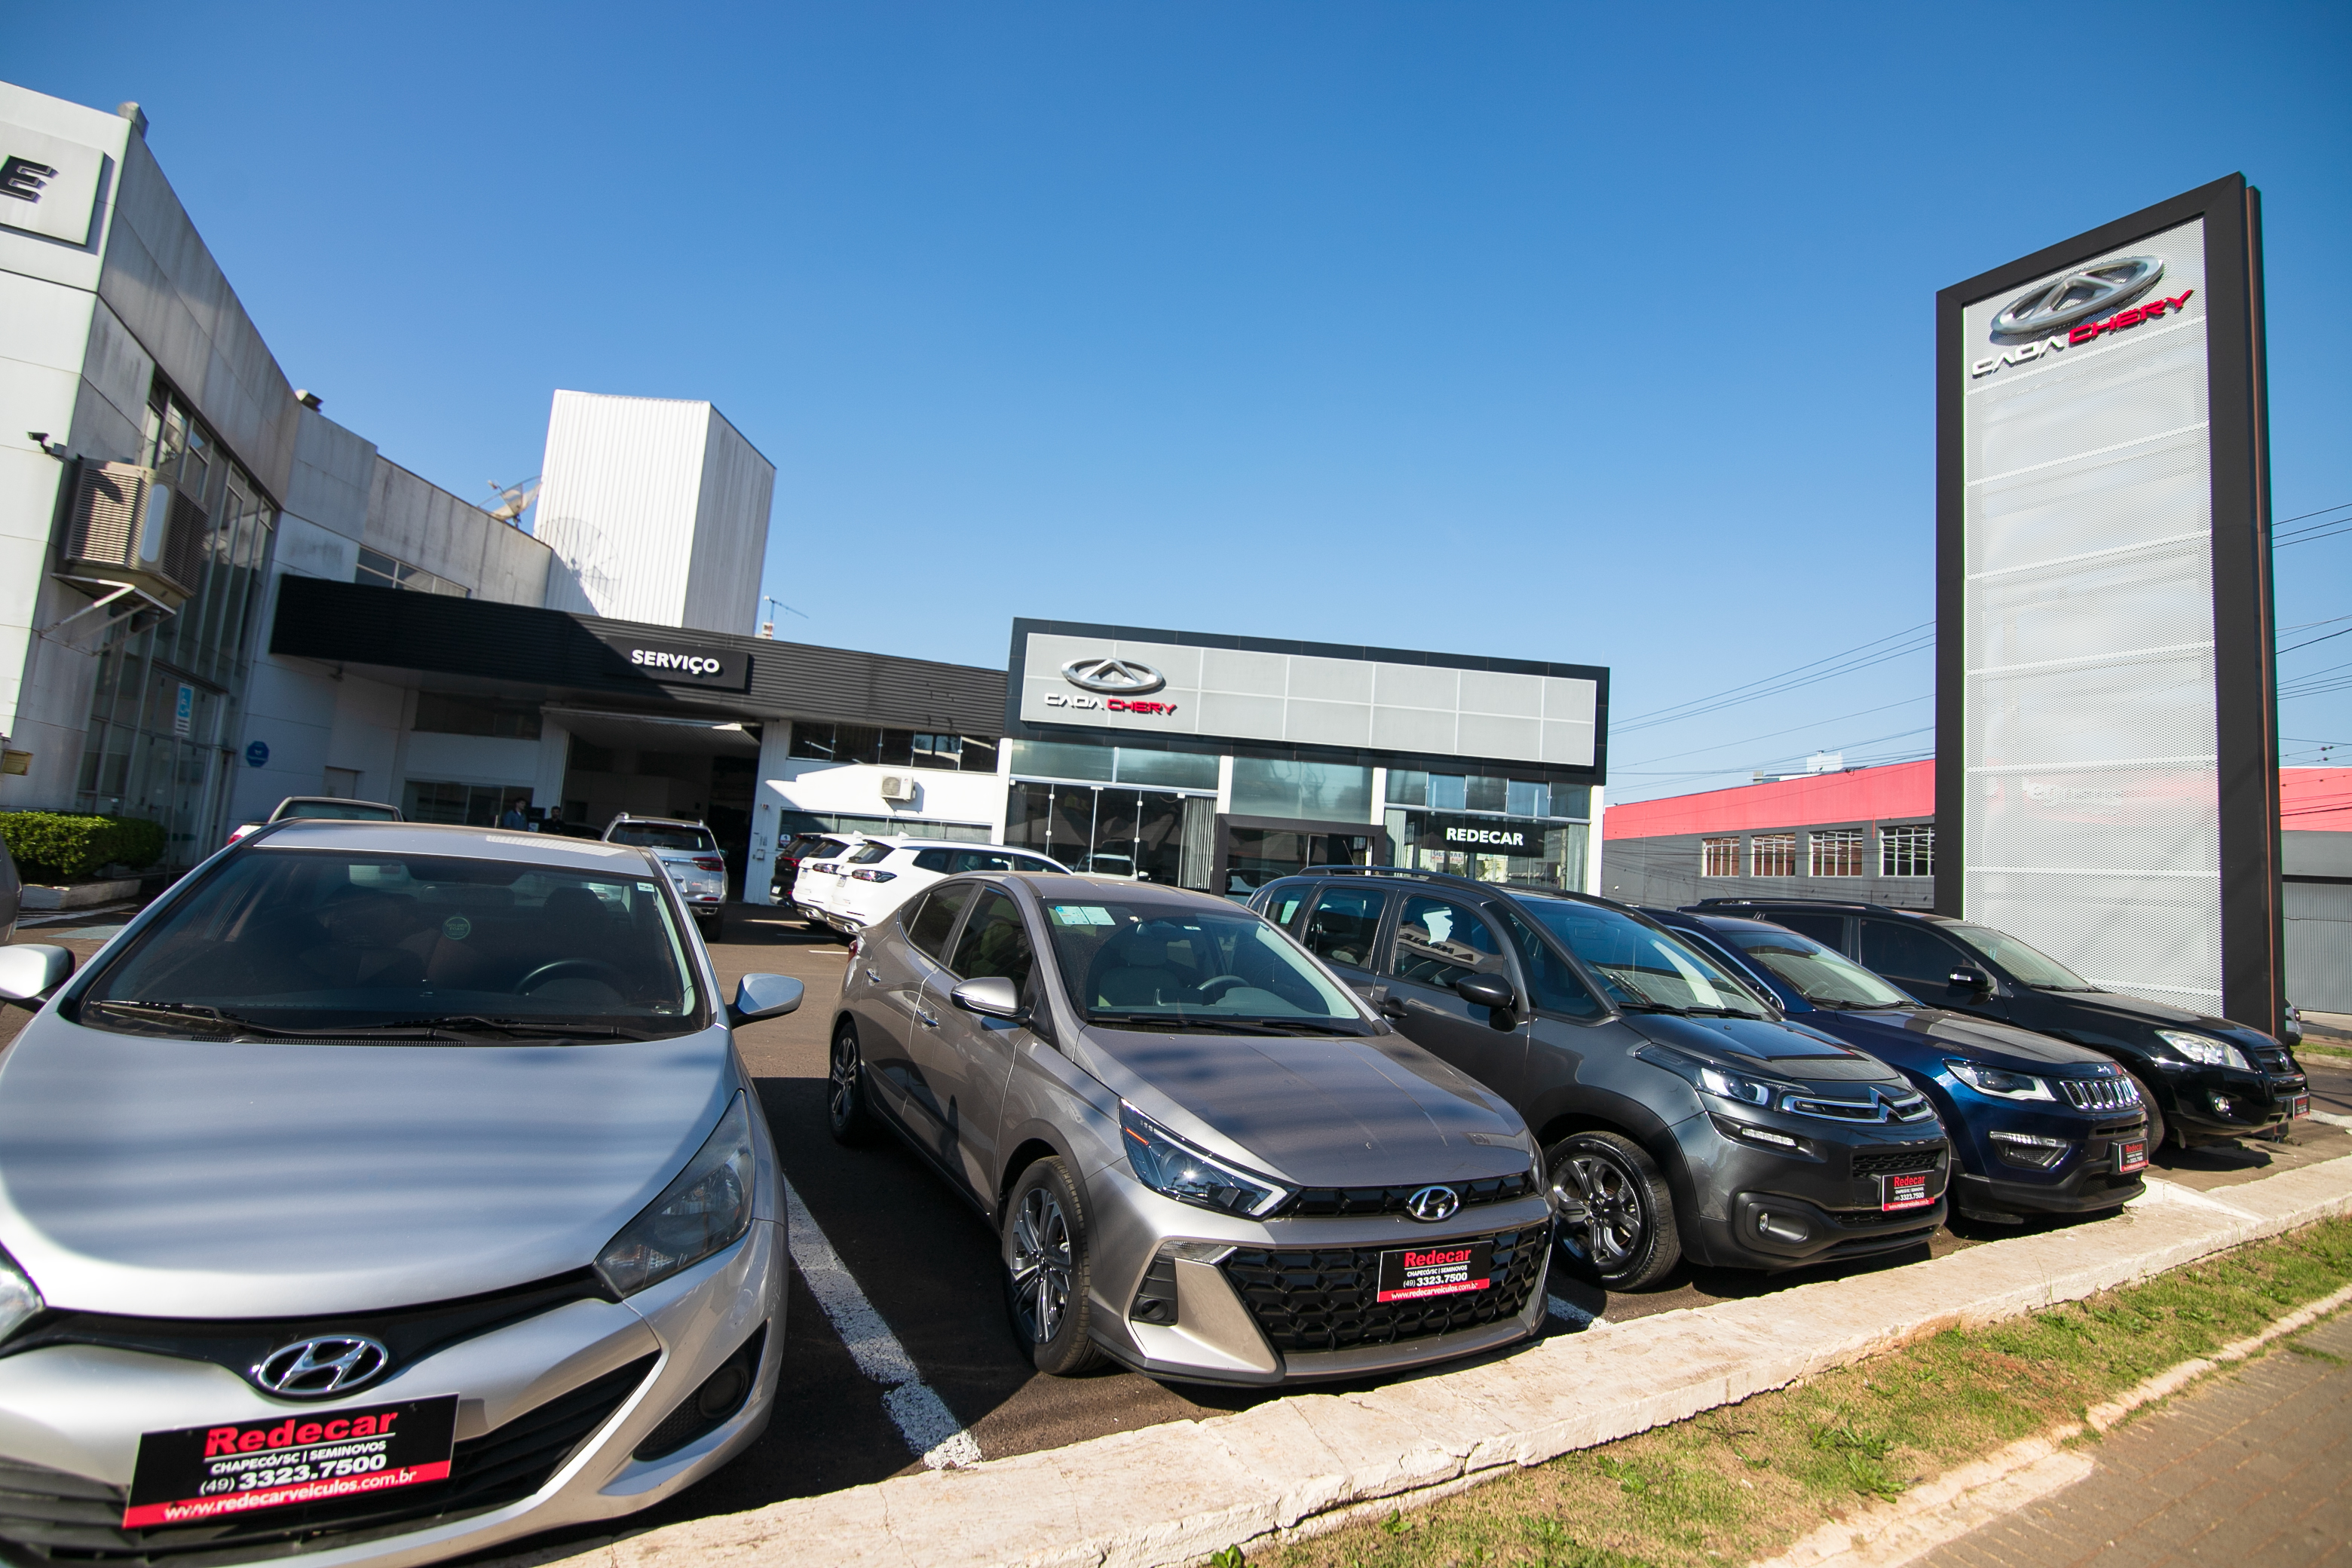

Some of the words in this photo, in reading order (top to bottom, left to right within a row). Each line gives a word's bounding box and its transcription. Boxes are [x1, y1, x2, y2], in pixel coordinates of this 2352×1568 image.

[0, 155, 53, 201] E
[1971, 335, 2063, 375] CAOA
[2069, 289, 2193, 343] CHERY
[631, 649, 720, 675] SERVIÇO
[1044, 692, 1104, 709] CAOA
[1107, 698, 1177, 714] CHERY
[1446, 827, 1524, 846] REDECAR
[1894, 1175, 1925, 1187] Redecar
[1404, 1249, 1472, 1267] Redecar
[1407, 1268, 1438, 1277] CHAPECÓ/SC
[1441, 1265, 1467, 1274] SEMINOVOS
[1403, 1279, 1416, 1288] (49)
[1416, 1272, 1468, 1287] 3323.7500
[204, 1411, 399, 1457] Redecar
[210, 1451, 299, 1476] CHAPECÓ/SC
[309, 1441, 387, 1462] SEMINOVOS
[200, 1478, 235, 1496] (49)
[239, 1454, 387, 1490] 3323.7500
[164, 1468, 417, 1521] www.redecarveiculos.com.br
